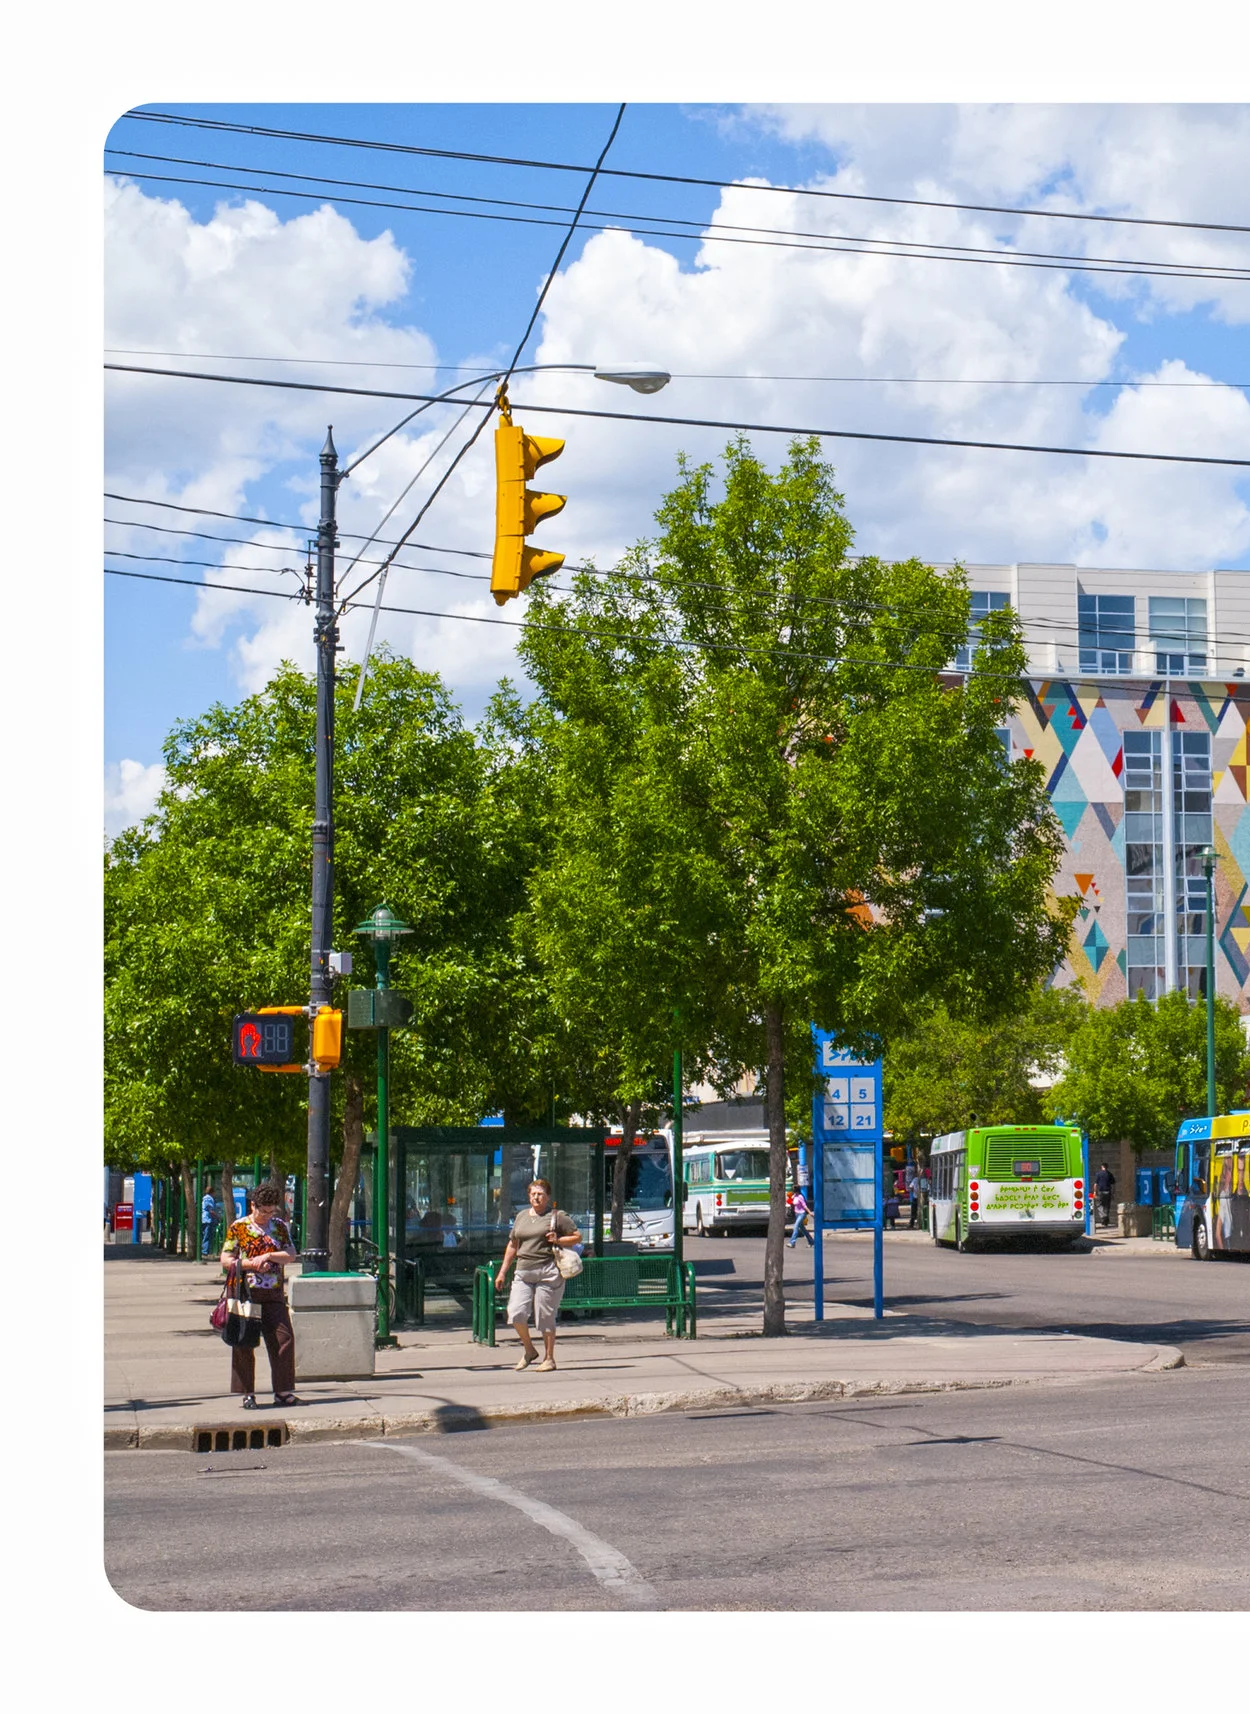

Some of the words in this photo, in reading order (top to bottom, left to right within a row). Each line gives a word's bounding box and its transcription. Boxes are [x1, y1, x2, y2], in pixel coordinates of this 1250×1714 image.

[832, 1089, 841, 1100] 4
[859, 1089, 867, 1099] 5
[828, 1116, 844, 1126] 12
[856, 1116, 871, 1126] 21
